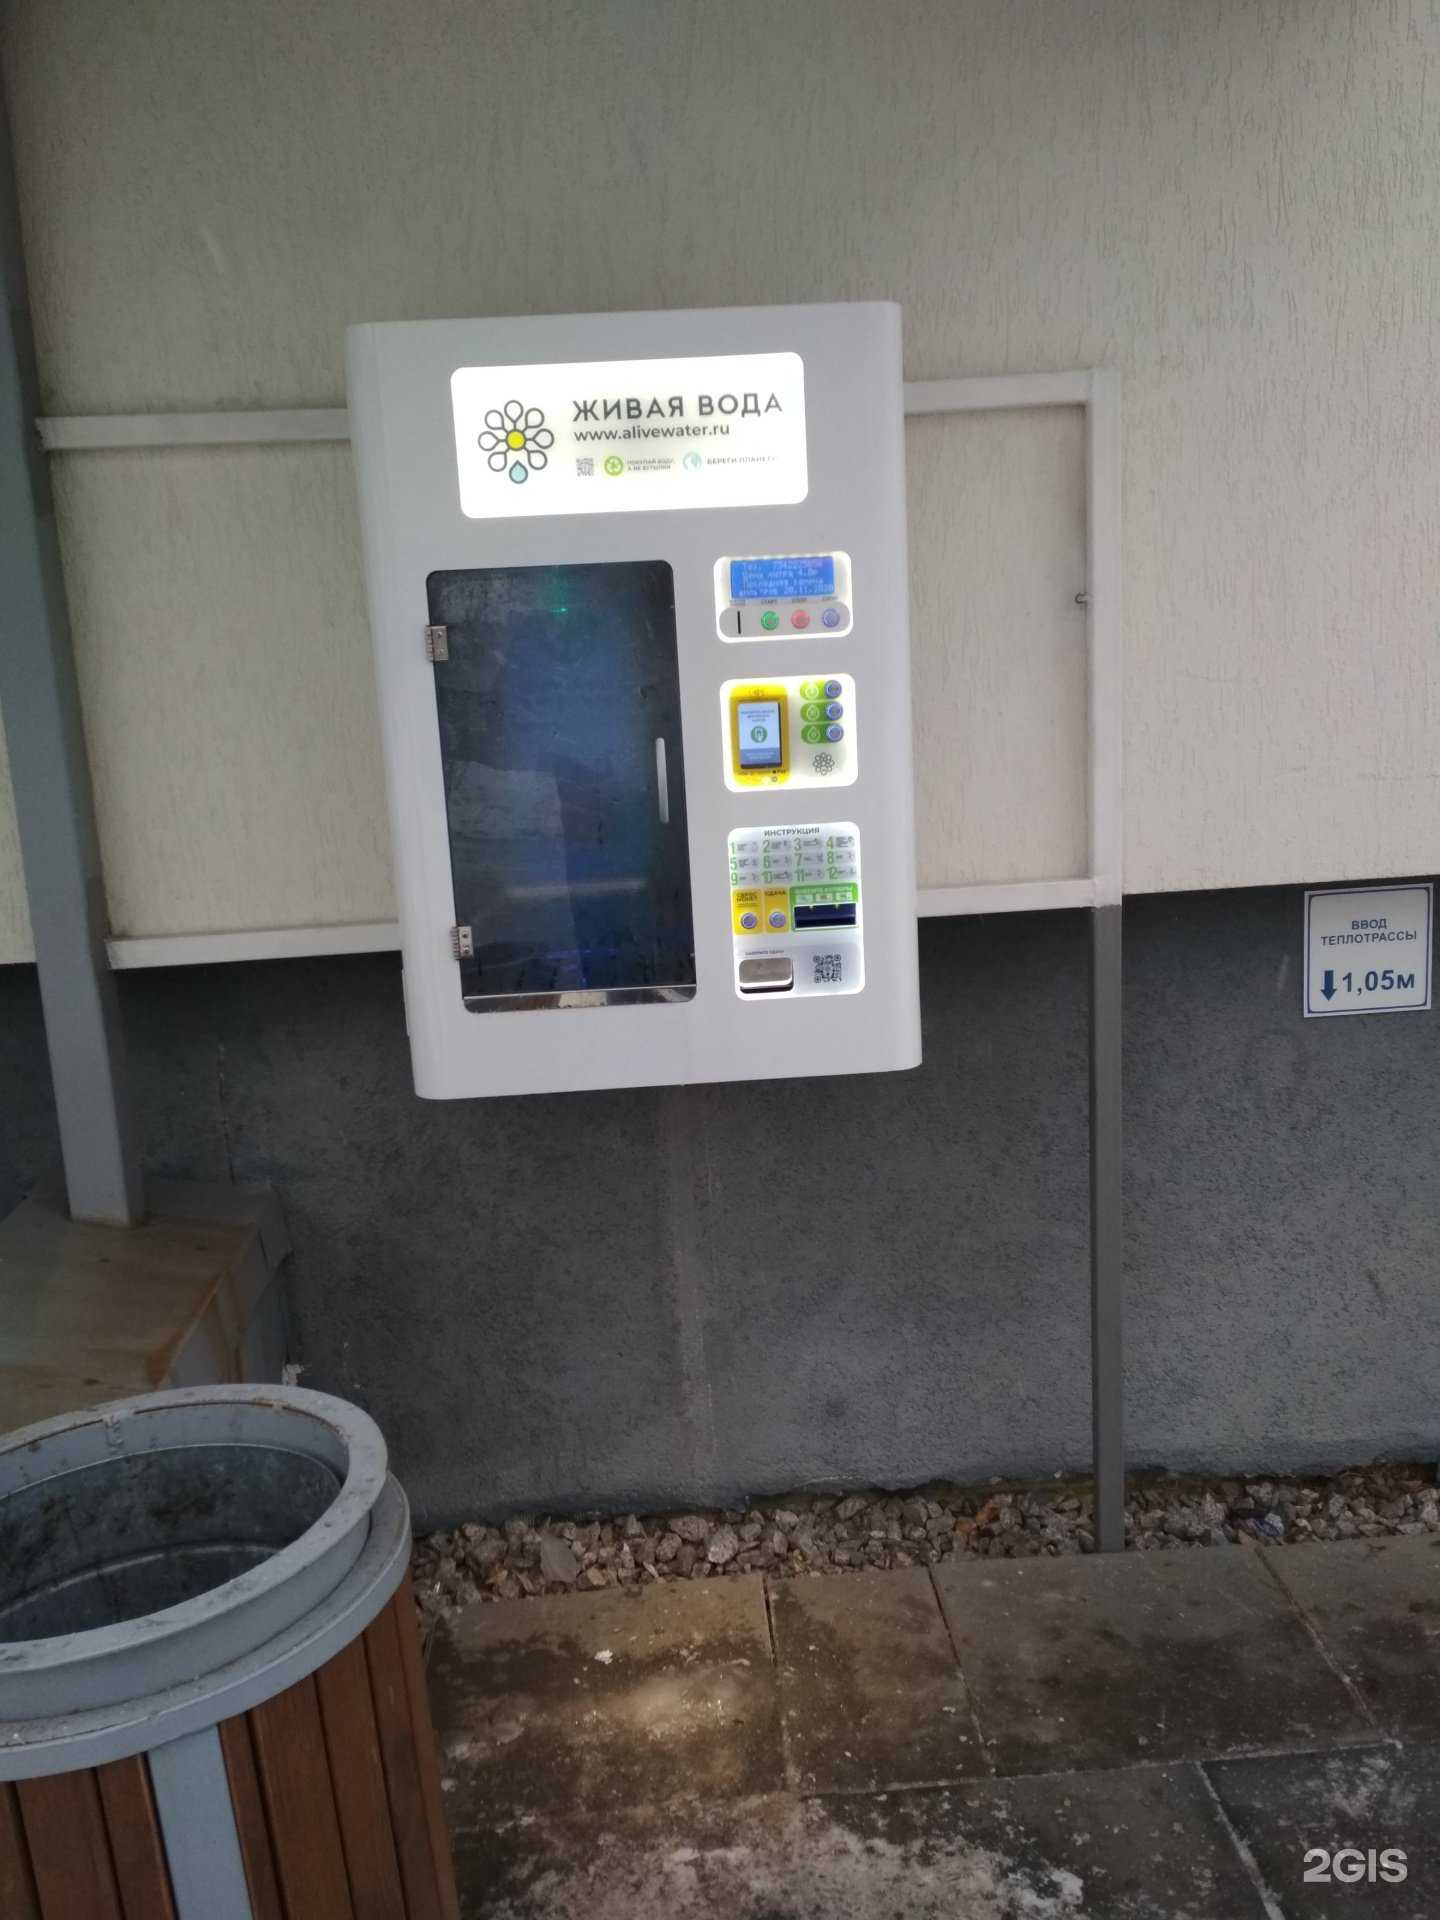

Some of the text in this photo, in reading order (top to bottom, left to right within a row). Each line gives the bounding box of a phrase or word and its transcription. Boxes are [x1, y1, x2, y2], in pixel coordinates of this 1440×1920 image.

[572, 392, 783, 422] ЖИВАЯ ВОДА
[574, 424, 730, 441] www.alivewater.ru
[764, 827, 820, 836] ИНСТРУКЦИЯ
[763, 840, 770, 853] 2
[794, 838, 801, 851] 3
[826, 836, 834, 849] 4
[730, 857, 737, 870] 5
[763, 855, 771, 869] 6
[794, 853, 802, 866] 7
[827, 851, 834, 864] 8
[731, 872, 738, 886] 9
[826, 867, 838, 880] 12
[1351, 918, 1388, 930] ВВОД
[1320, 930, 1417, 946] ТЕПЛОТРАССЫ
[1342, 969, 1416, 996] 1,05м
